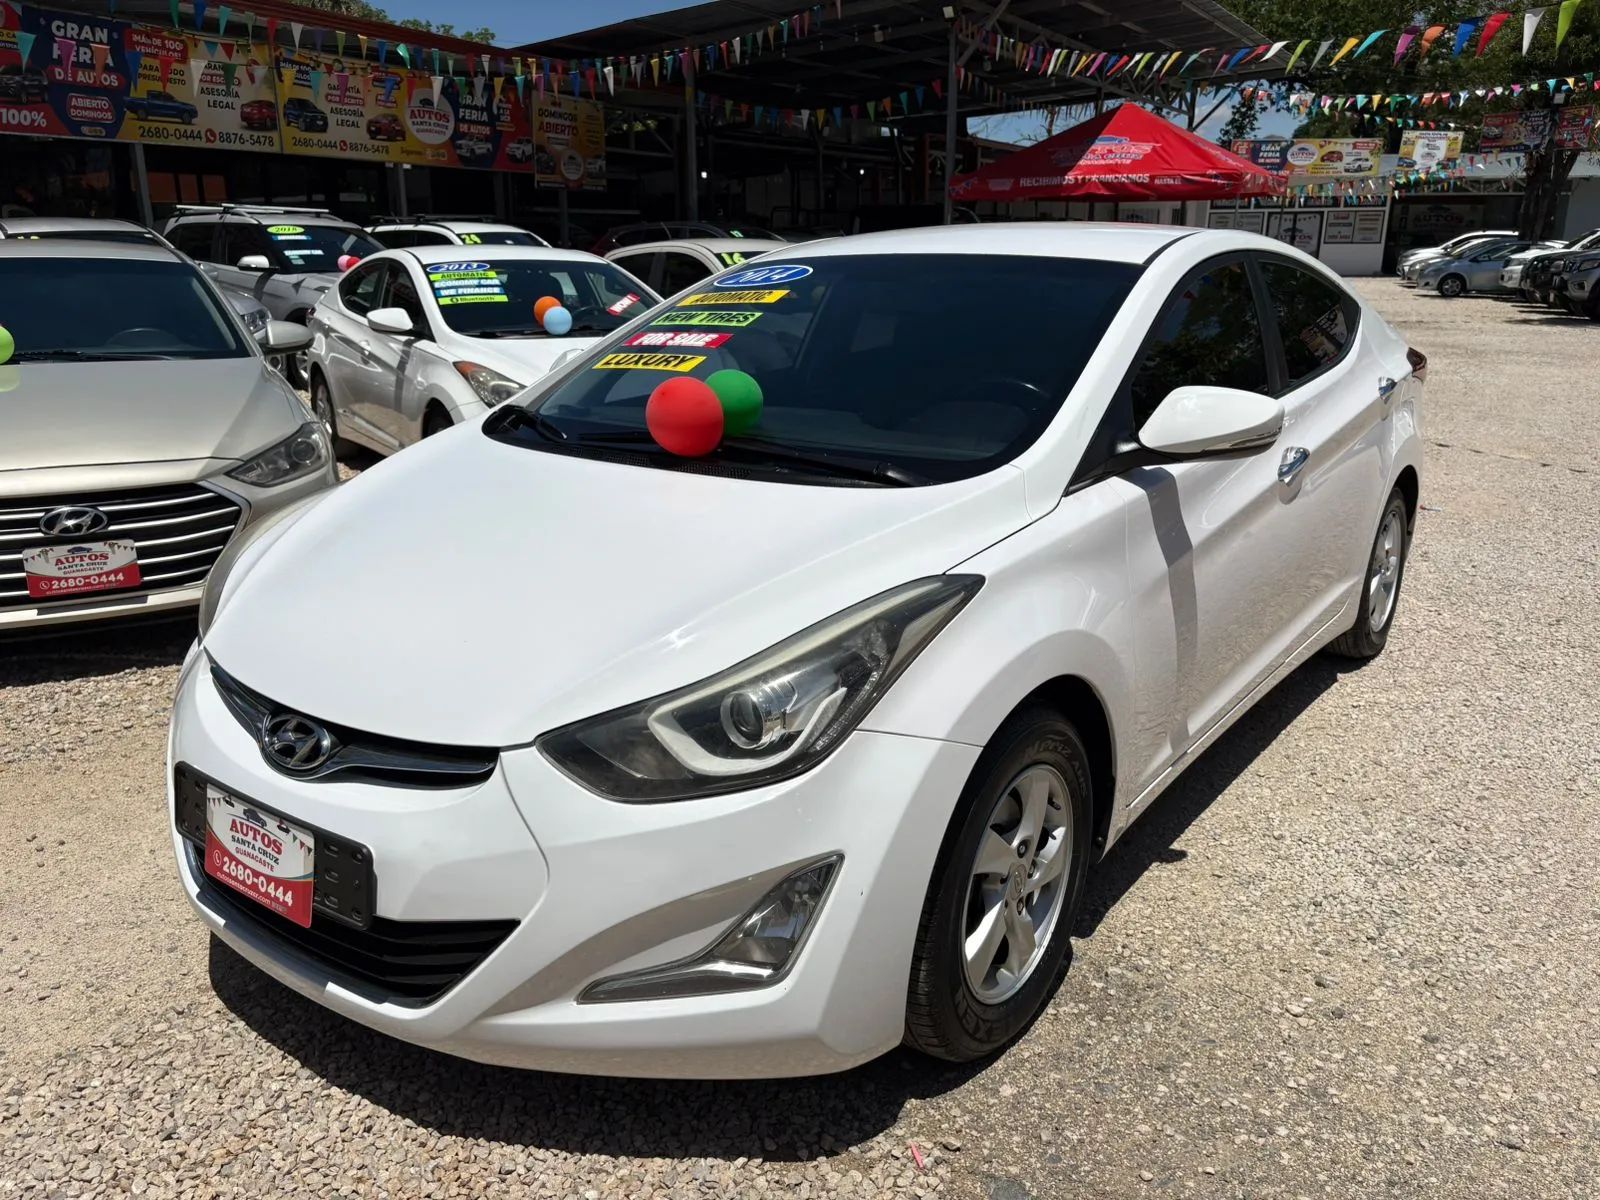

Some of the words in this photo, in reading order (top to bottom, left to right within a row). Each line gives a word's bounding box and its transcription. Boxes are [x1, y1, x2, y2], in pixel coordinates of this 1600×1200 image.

[51, 20, 109, 44] GRAN
[76, 72, 119, 87] AUOS
[71, 98, 109, 110] ABIERTO
[207, 99, 236, 110] LEGAL
[0, 107, 47, 128] 100%
[70, 108, 113, 119] DOMINGOS
[409, 109, 450, 123] AUTOS
[459, 108, 488, 122] FERIA
[538, 109, 577, 122] DOMINGOS
[336, 118, 360, 128] LEGAL
[470, 124, 491, 135] AUTOS
[538, 122, 579, 136] ABIERTO
[139, 126, 202, 140] 2680-0444
[218, 132, 275, 147] 8876-5478
[292, 137, 338, 149] 2680-0444
[1020, 175, 1076, 187] RECIBIMOS
[1077, 175, 1084, 184] Y
[440, 263, 478, 271] 2013
[441, 271, 489, 279] AUTOMATIC
[722, 268, 803, 284] 2014
[689, 290, 774, 304] AUTOMATIC
[661, 312, 699, 324] NEW
[700, 312, 756, 325] TIRES
[631, 333, 669, 346] FOR
[666, 333, 719, 347] SALE
[600, 354, 696, 368] LUXURY
[55, 552, 109, 567] AUTOS
[58, 563, 85, 571] SANTA
[63, 566, 104, 575] GUANACASTE
[52, 573, 124, 589] 2680-0444
[230, 818, 283, 856] AUTOS
[231, 835, 256, 854] SANTA
[258, 847, 280, 866] CRUZ
[235, 847, 275, 873] GUANACASTE
[222, 856, 293, 907] 2680-0444
